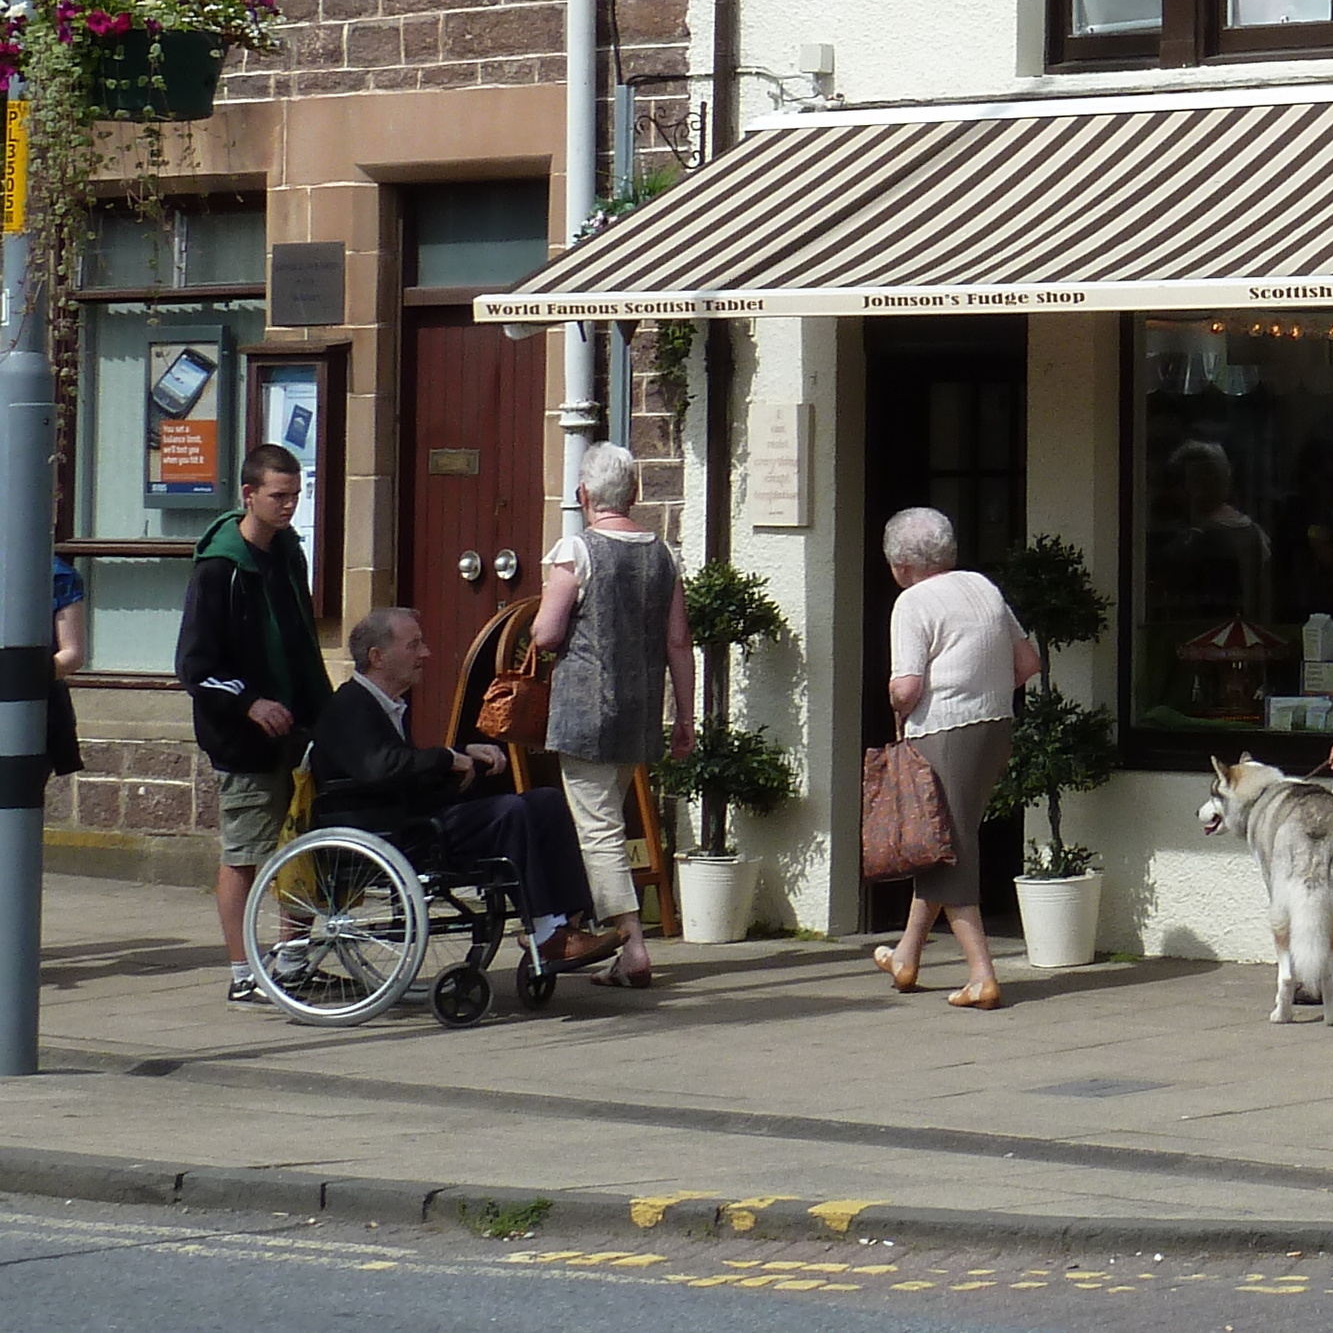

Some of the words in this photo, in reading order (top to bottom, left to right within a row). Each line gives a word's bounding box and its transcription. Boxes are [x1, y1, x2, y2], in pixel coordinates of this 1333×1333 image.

[862, 293, 960, 309] Johnson's
[967, 292, 1030, 306] Fudge
[1036, 291, 1086, 304] shop
[1248, 284, 1333, 300] Scottish
[486, 303, 541, 316] World
[547, 302, 619, 316] Famous
[624, 300, 696, 314] Scottish
[702, 298, 765, 312] Tablet
